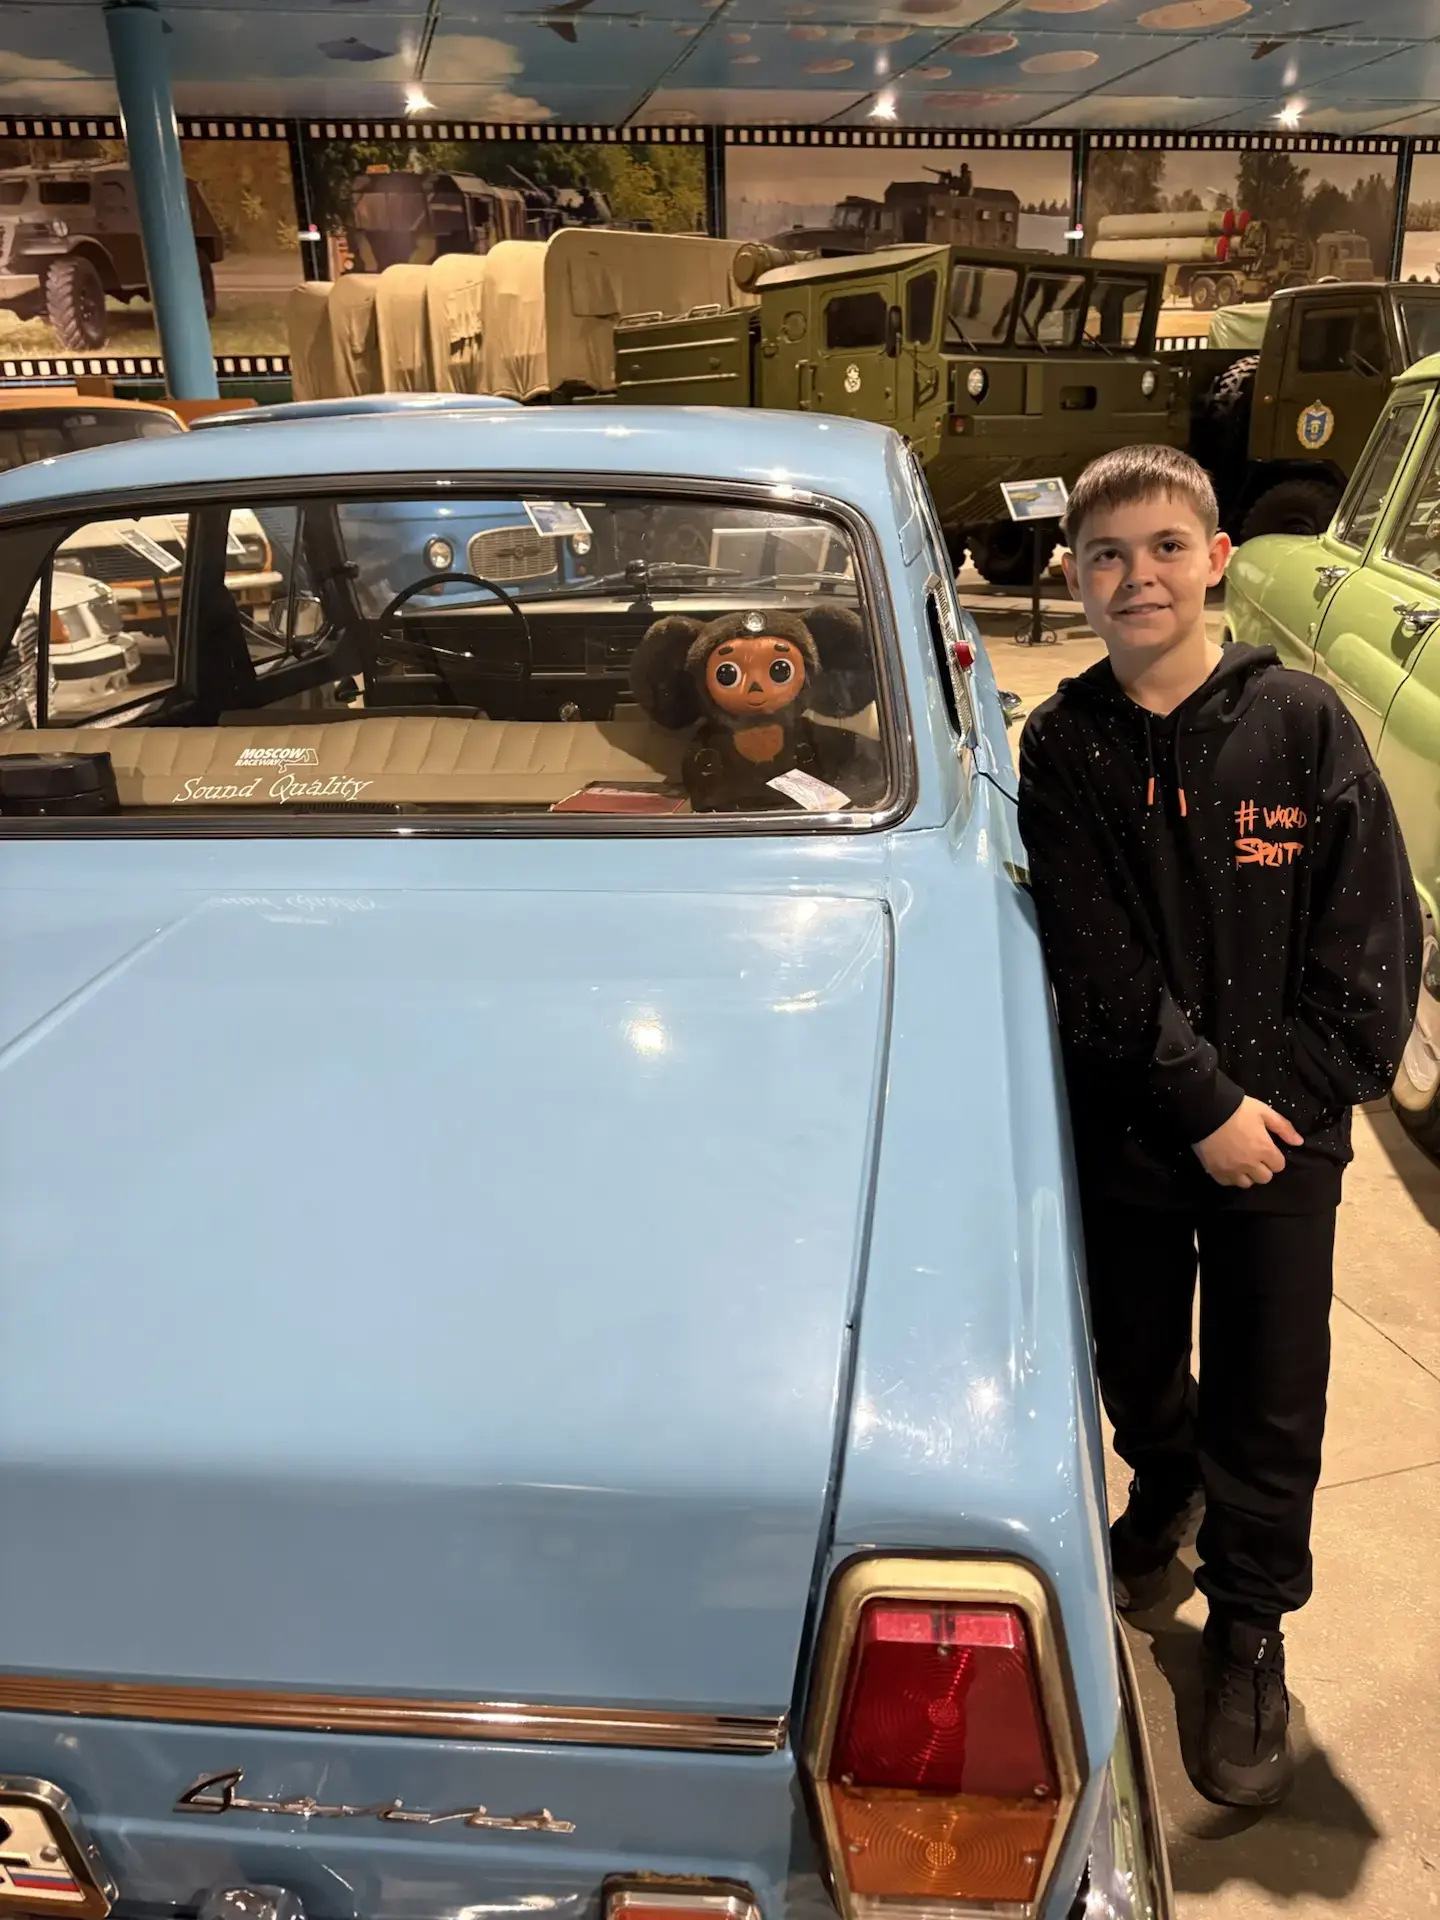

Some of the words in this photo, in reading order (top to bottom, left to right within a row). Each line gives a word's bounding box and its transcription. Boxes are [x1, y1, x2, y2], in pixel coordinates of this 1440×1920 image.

[238, 748, 305, 759] MOSCOW
[234, 759, 281, 767] RACEWAY
[172, 776, 263, 804] Sound
[268, 773, 375, 805] Quality
